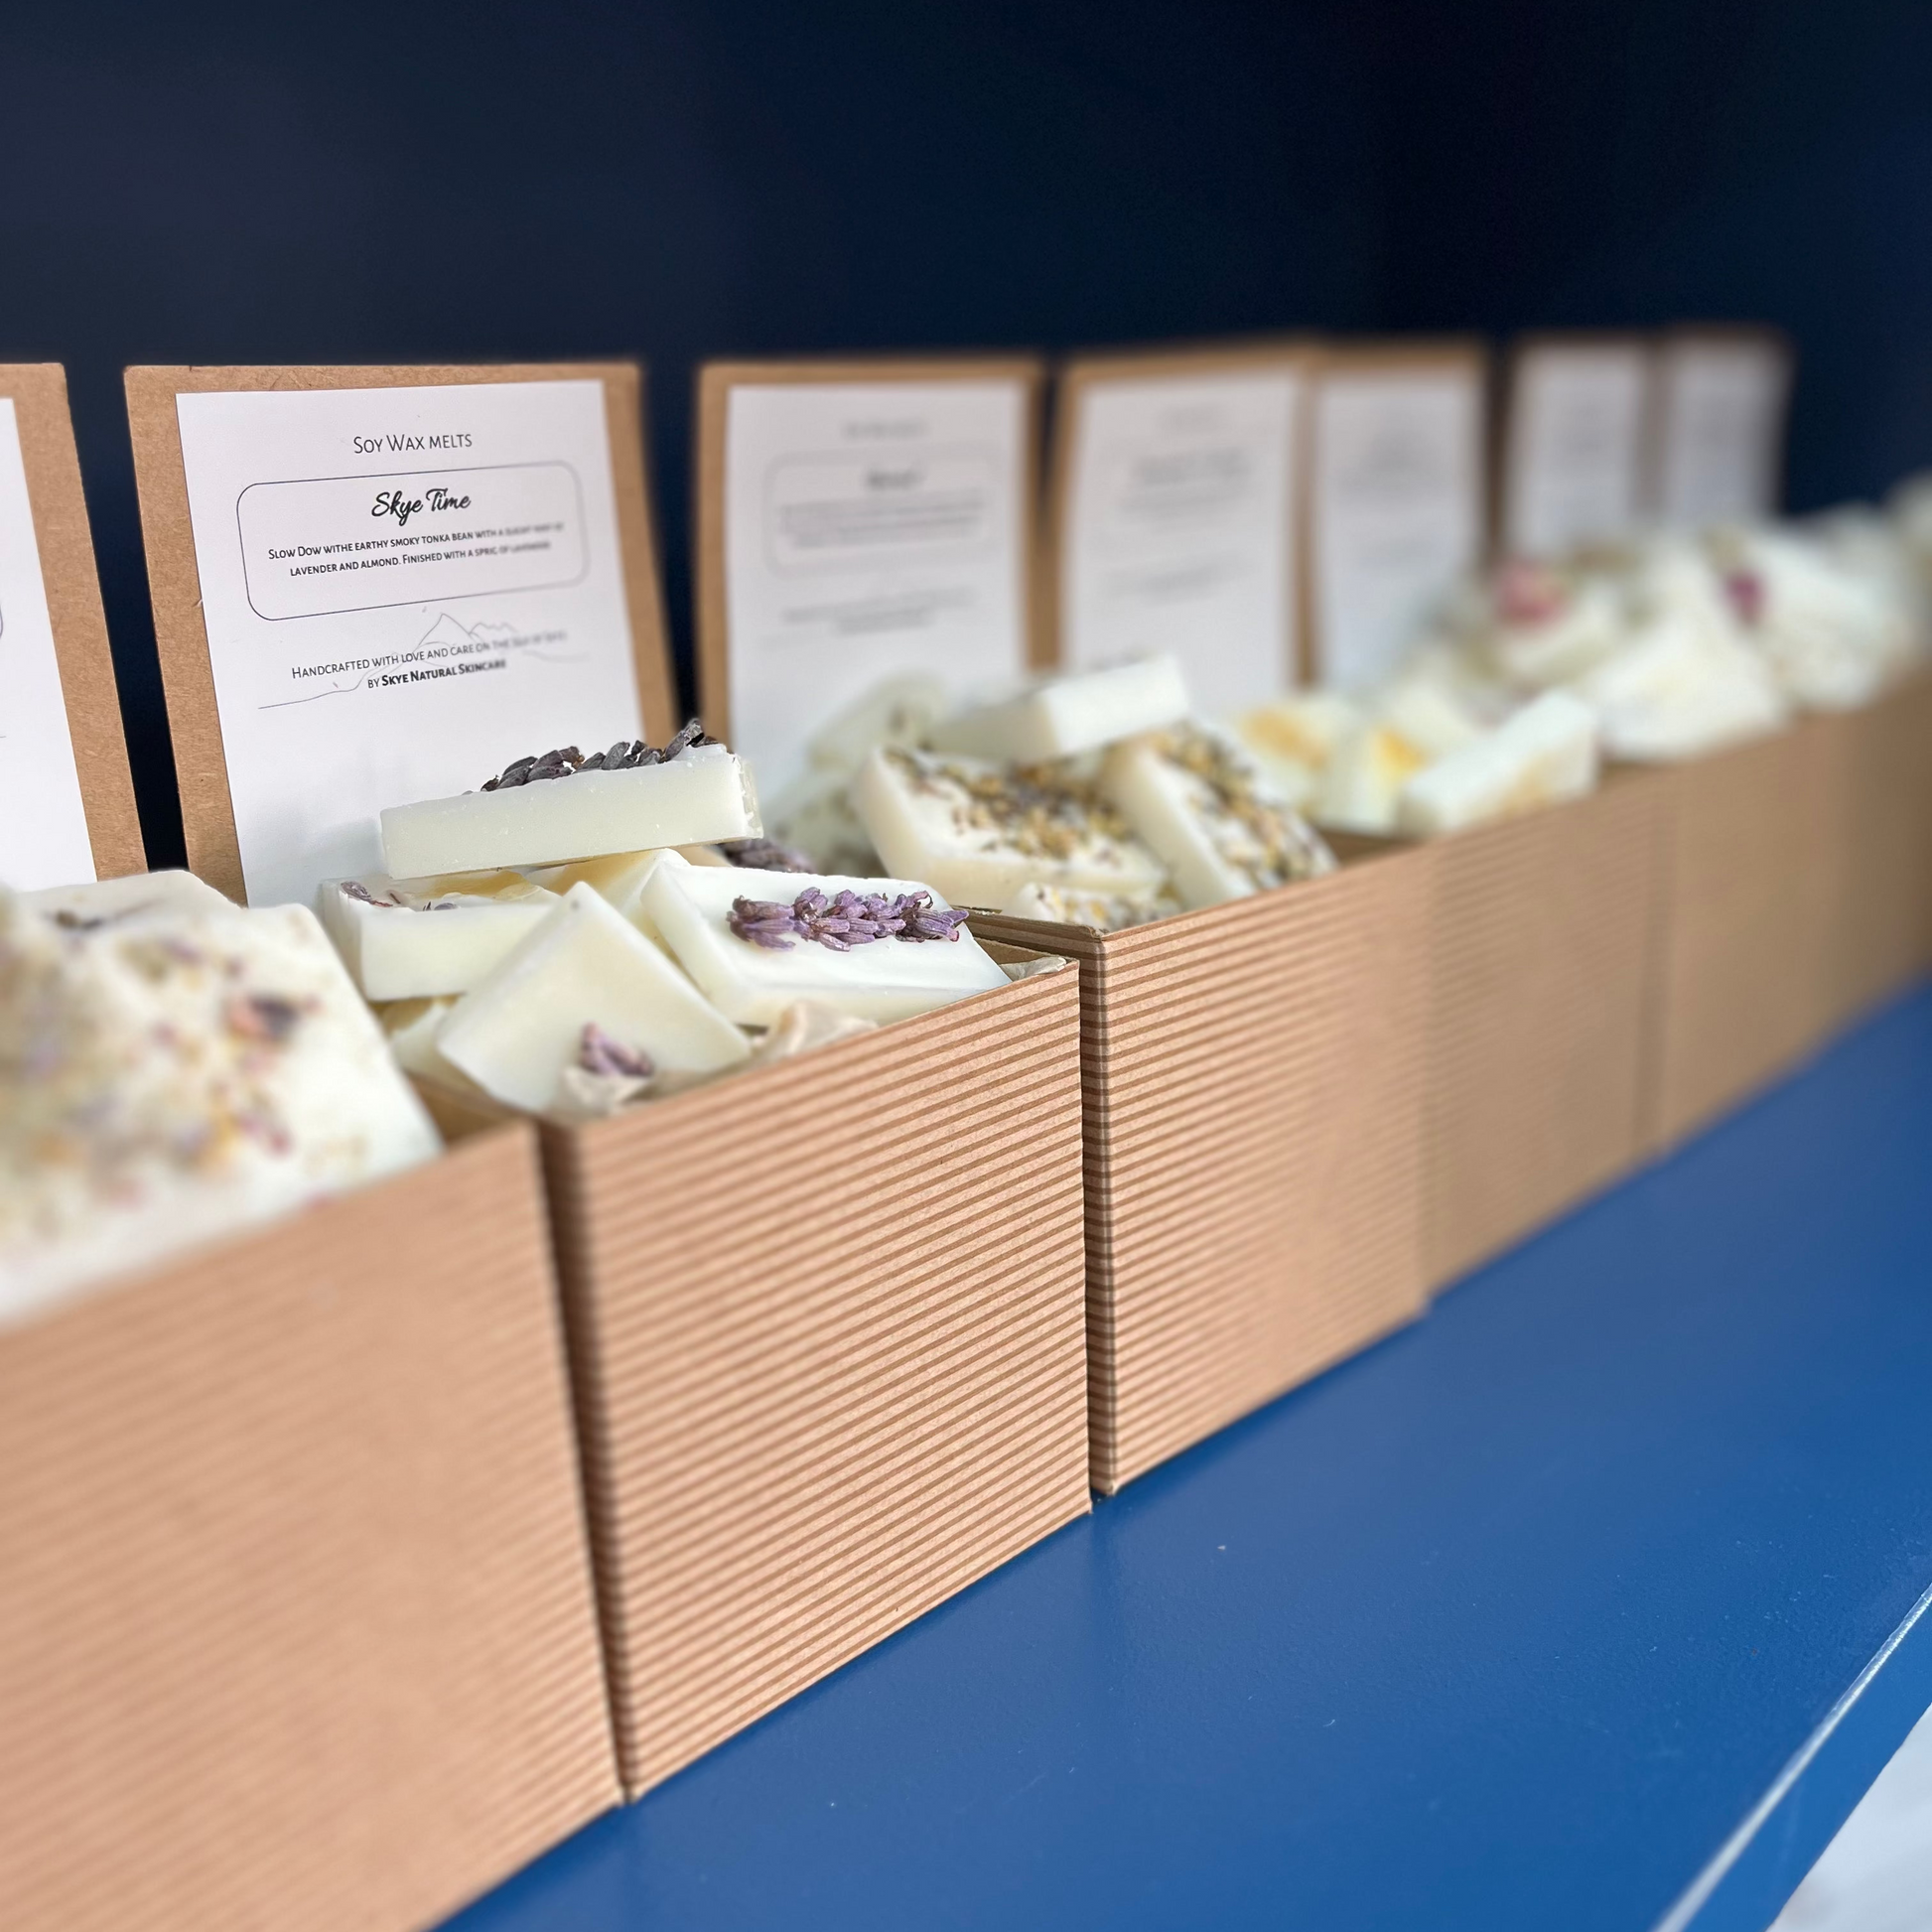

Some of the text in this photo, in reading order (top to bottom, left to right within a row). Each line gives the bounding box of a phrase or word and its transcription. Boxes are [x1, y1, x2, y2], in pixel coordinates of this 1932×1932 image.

[353, 434, 473, 454] SOY WAX MELTS
[371, 487, 472, 527] Skye Time
[268, 548, 296, 560] SLOW
[298, 545, 322, 557] DOW
[323, 543, 353, 554] WITHE
[354, 539, 389, 551] EARTHY
[390, 536, 420, 548] SMOKY
[421, 533, 451, 544] TONKA
[452, 530, 474, 541] BEAN
[475, 528, 496, 539] WITH
[290, 564, 338, 577] LAVENDER
[339, 561, 359, 572] AND
[402, 554, 443, 565] FINISHED
[443, 550, 467, 560] WITH
[468, 549, 474, 558] A
[292, 659, 370, 679] HANDCRAFTED
[371, 655, 399, 668] WITH
[401, 651, 425, 664] LOVE
[426, 647, 449, 660] AND
[450, 642, 475, 656] CARE
[367, 678, 380, 689] BY
[381, 673, 409, 687] SKYE
[410, 666, 458, 682] NATURAL
